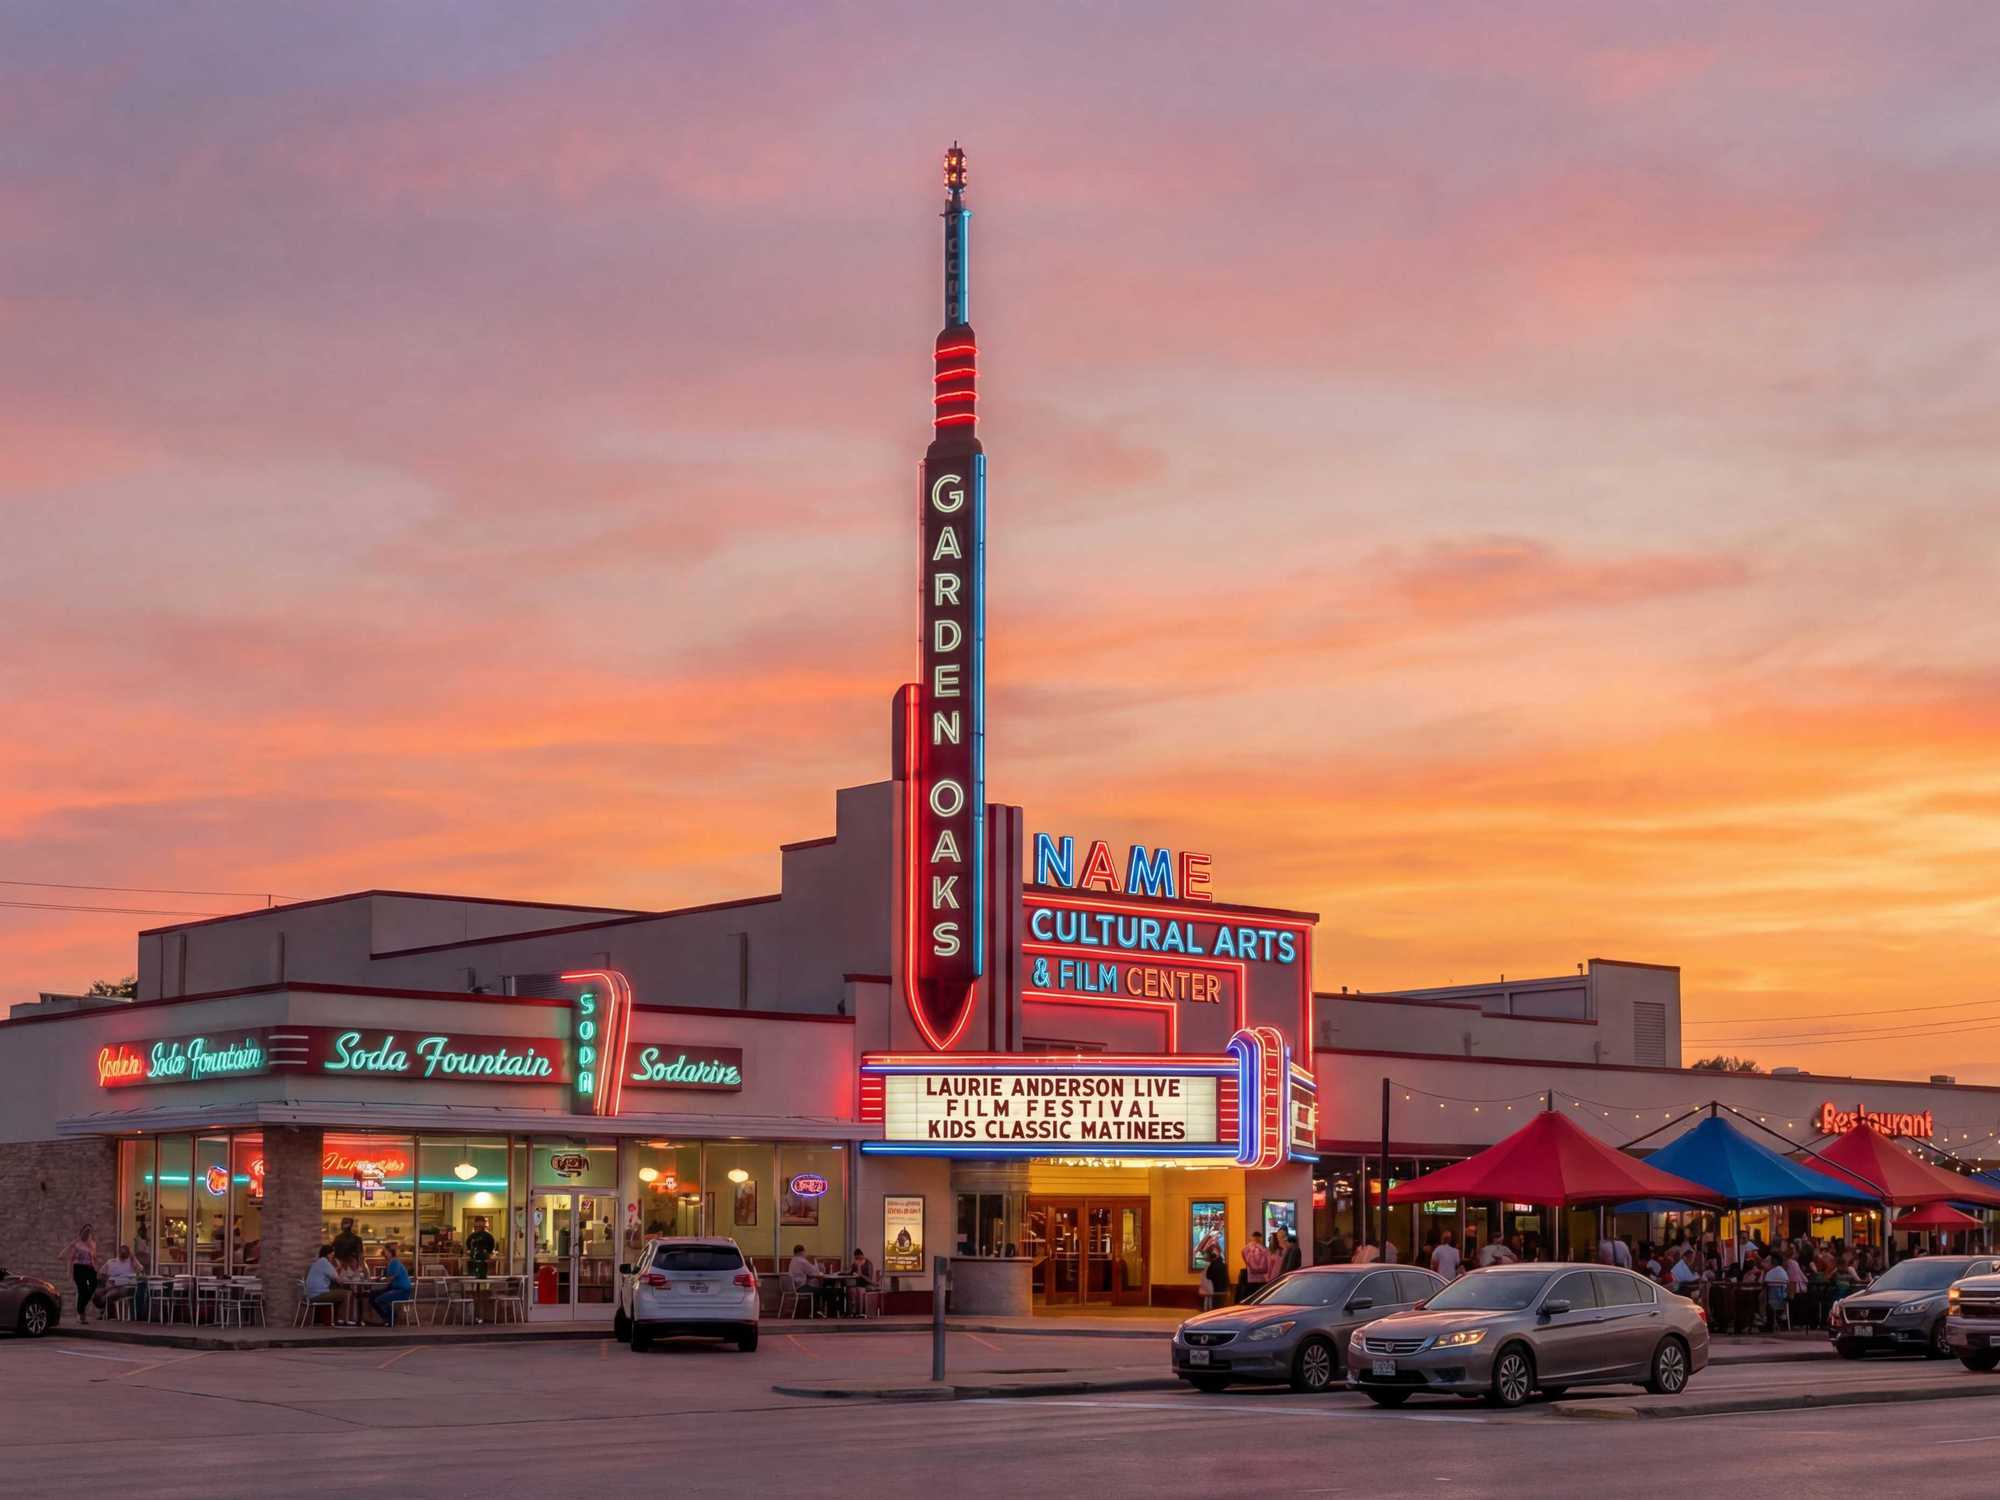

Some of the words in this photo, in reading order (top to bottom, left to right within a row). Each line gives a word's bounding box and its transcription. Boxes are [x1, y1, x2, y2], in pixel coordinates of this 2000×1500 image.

[931, 473, 965, 745] GARDEN
[929, 779, 965, 957] OAKS
[1033, 831, 1213, 902] NAME
[1030, 908, 1204, 955] CULTURAL
[1213, 925, 1296, 964] ARTS
[1032, 957, 1050, 988] &
[1058, 959, 1118, 993] FILM
[1126, 966, 1222, 1003] CENTER
[324, 1031, 410, 1071] Soda
[416, 1036, 553, 1078] Fountain
[578, 993, 595, 1093] SODA
[926, 1077, 1003, 1097] LAURIE
[1010, 1078, 1129, 1098] ANDERSON
[1134, 1078, 1181, 1097] LIVE
[946, 1099, 1010, 1118] FILM
[1026, 1099, 1160, 1118] FESTIVAL
[928, 1119, 977, 1139] KIDS
[985, 1120, 1072, 1139] CLASSIC
[1081, 1121, 1186, 1140] MATINEES
